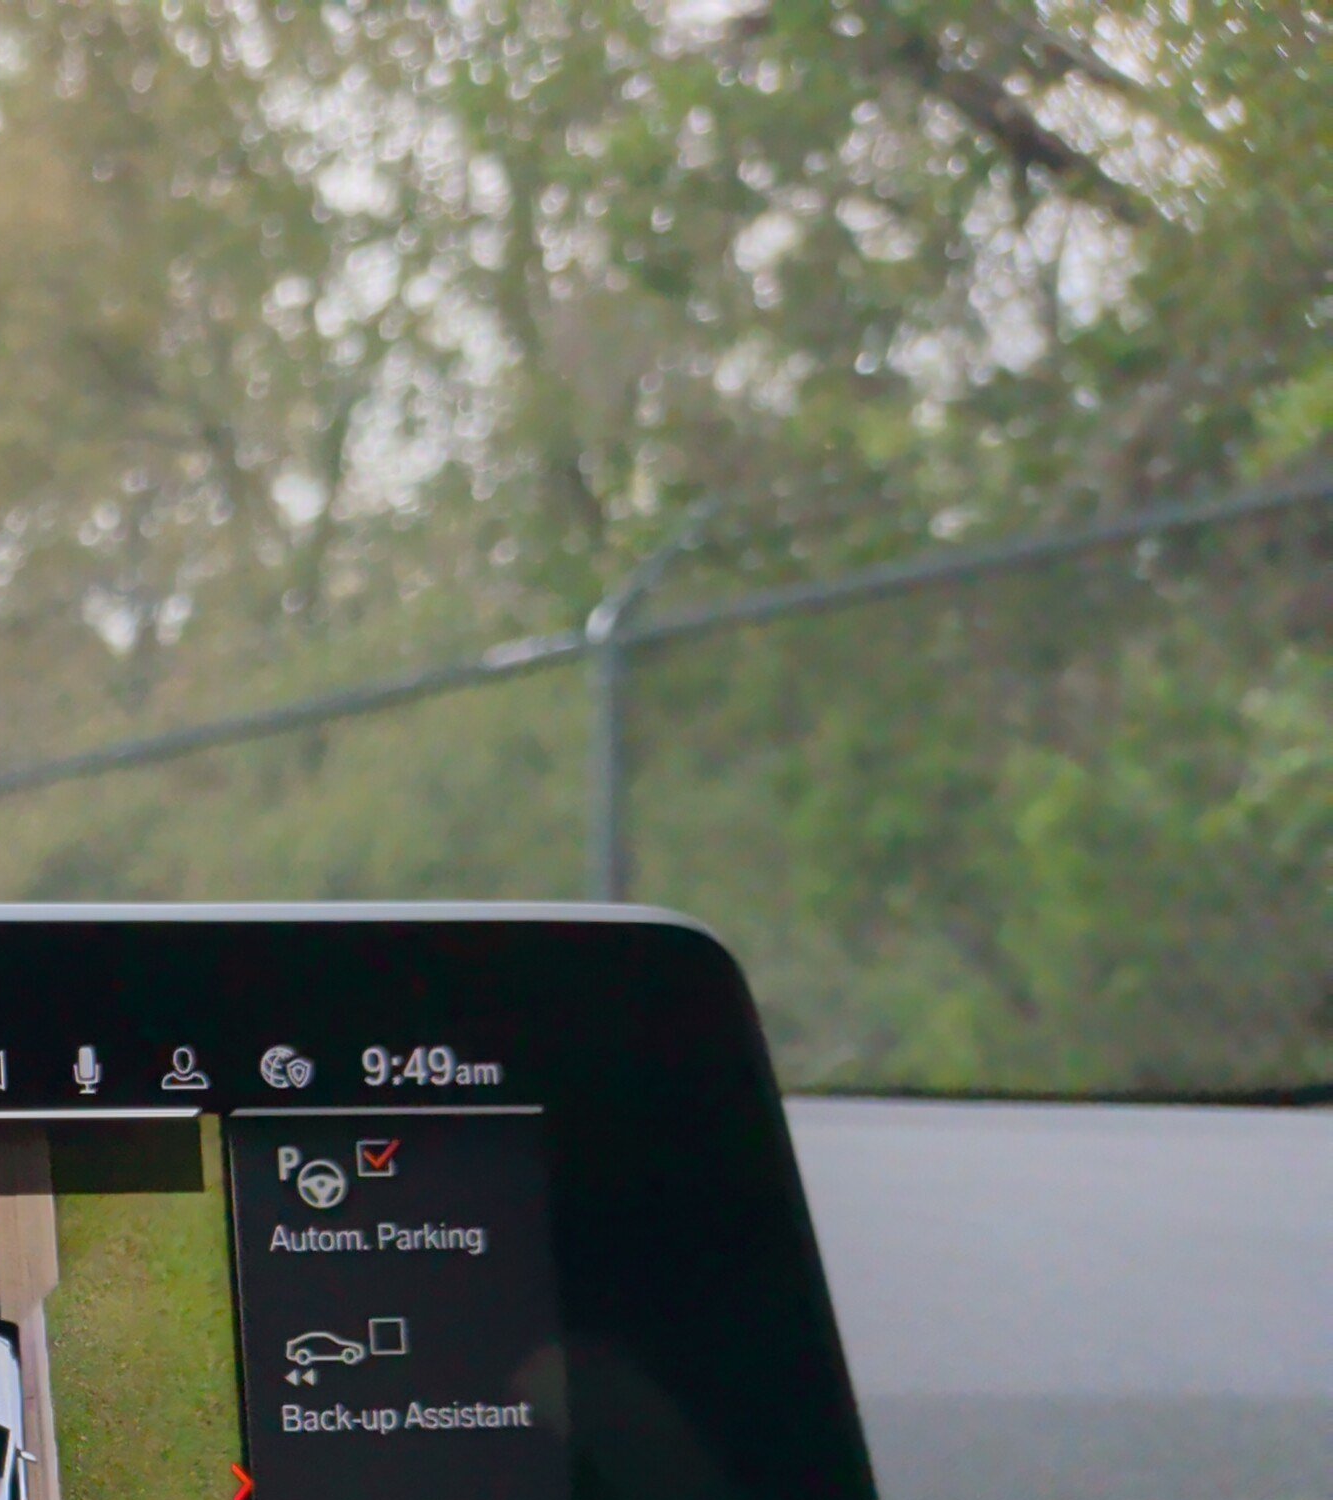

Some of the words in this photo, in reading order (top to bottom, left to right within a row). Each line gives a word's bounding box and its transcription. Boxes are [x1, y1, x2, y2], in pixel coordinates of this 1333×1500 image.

[361, 1046, 501, 1087] 9:49am
[277, 1146, 300, 1182] P
[270, 1224, 371, 1252] Autom.
[377, 1222, 486, 1256] Parking
[282, 1403, 398, 1435] Back-up
[404, 1401, 532, 1430] Assistant
